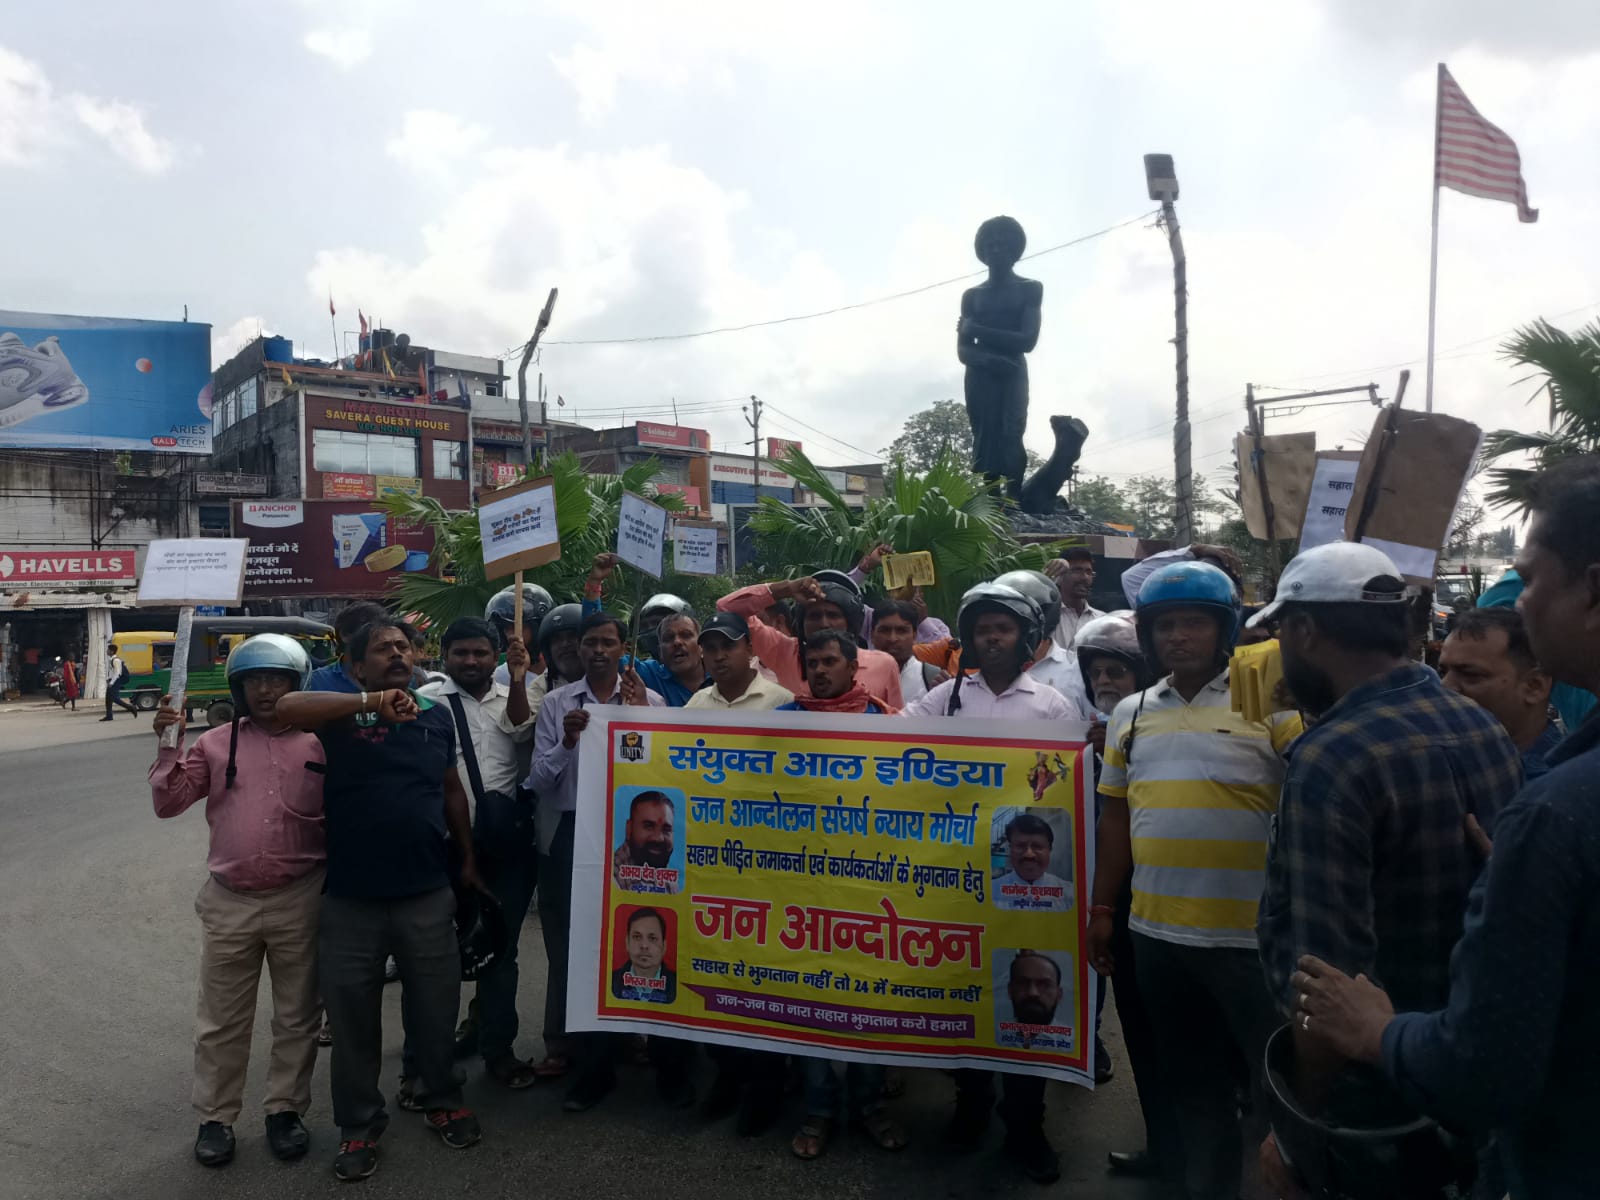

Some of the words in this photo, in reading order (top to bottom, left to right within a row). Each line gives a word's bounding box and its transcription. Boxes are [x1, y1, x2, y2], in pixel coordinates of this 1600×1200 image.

[325, 409, 371, 423] SAVERA
[375, 414, 411, 428] GUEST
[415, 419, 451, 432] HOUSE
[169, 424, 207, 435] ARIES
[152, 438, 176, 446] BALL
[180, 438, 205, 446] TECH
[713, 464, 749, 475] EXECUTIVE
[1327, 480, 1353, 491] सहारा
[258, 504, 297, 512] ANCHOR
[1321, 505, 1346, 516] सहारा
[275, 542, 290, 553] जो
[20, 558, 123, 574] HAVELLS
[245, 566, 293, 576] कनेक्शन
[620, 745, 644, 759] UNITY
[668, 739, 777, 784] संयुक्त
[783, 752, 867, 781] आल
[873, 747, 1006, 787] इण्डिया
[690, 796, 726, 825] जन
[729, 790, 817, 833] आन्दोलन
[821, 795, 870, 837] संघर्ष
[874, 808, 925, 841] न्याय
[929, 801, 980, 846] मोर्चा
[620, 865, 641, 879] अभय
[641, 862, 655, 880] देव
[655, 868, 678, 887] शुक्ल
[686, 844, 719, 867] सहारा
[720, 838, 754, 875] पीड़ित
[808, 848, 828, 877] एवं
[828, 849, 898, 884] कार्यकर्ताओं
[896, 855, 911, 885] के
[912, 864, 961, 899] भुगतान
[962, 860, 985, 904] हेतु
[691, 895, 772, 945] जन
[778, 896, 985, 969] आन्दोलन
[648, 976, 666, 990] शर्मा
[691, 957, 730, 975] सहारा
[732, 959, 746, 977] से
[748, 965, 800, 986] भुगतान
[803, 968, 833, 990] नहीं
[834, 972, 851, 992] तो
[854, 979, 869, 993] 24
[873, 977, 889, 996] में
[890, 982, 945, 1000] मतदान
[949, 984, 983, 1002] नहीं
[716, 993, 766, 1012] जन-जन
[768, 1000, 785, 1014] का
[787, 1003, 812, 1018] नारा
[814, 1007, 848, 1023] सहारा
[851, 1011, 898, 1030] भुगतान
[901, 1014, 927, 1031] करो
[930, 1018, 968, 1033] हमारा
